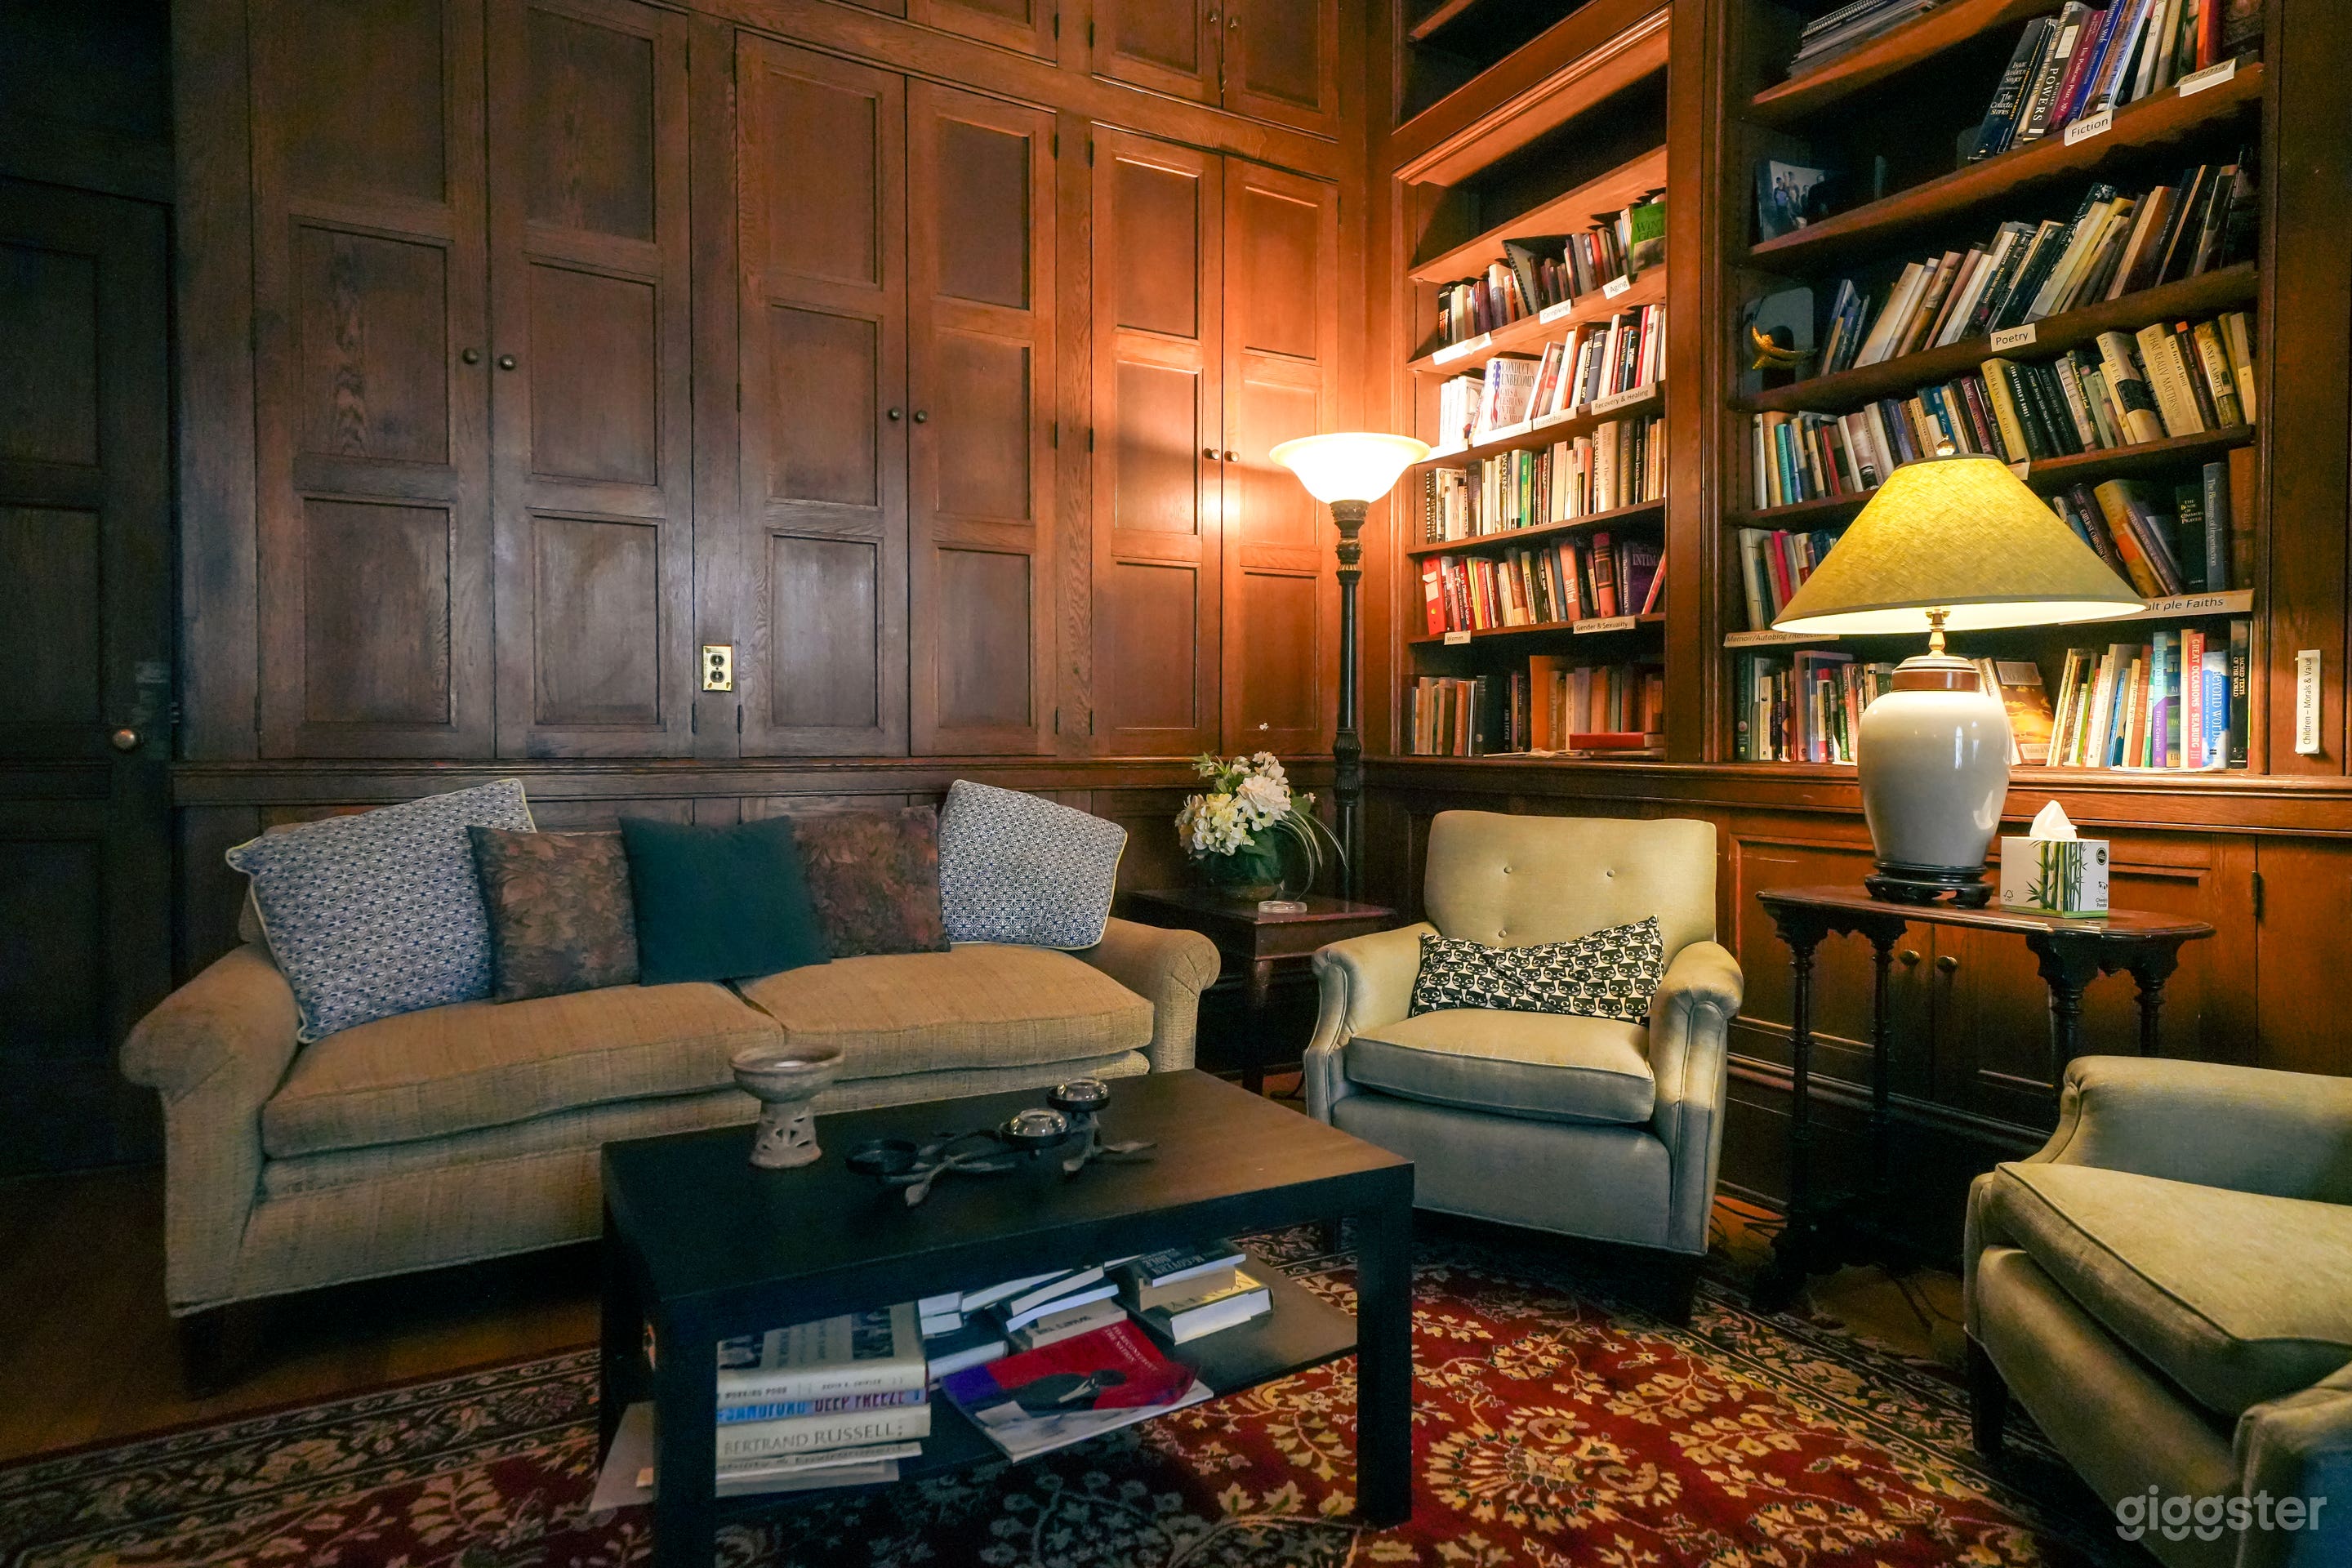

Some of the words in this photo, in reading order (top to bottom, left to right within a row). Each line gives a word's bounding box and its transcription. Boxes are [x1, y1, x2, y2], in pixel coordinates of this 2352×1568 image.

[2100, 27, 2111, 43] Web
[2004, 76, 2022, 84] Singer
[2183, 64, 2228, 82] Drama
[2001, 91, 2013, 100] The
[2032, 67, 2060, 122] POWERS
[2071, 118, 2109, 138] Fiction
[1610, 279, 1628, 293] Aging
[1542, 304, 1569, 319] Caregiving
[1995, 332, 2029, 345] Poetry
[2100, 337, 2121, 381] INSPIRED
[2148, 329, 2160, 350] WHAT
[2154, 351, 2168, 376] REALLY
[1502, 361, 1530, 375] CONDUCT
[2204, 341, 2212, 359] ANNE
[2210, 359, 2224, 393] LAMOTT
[1501, 373, 1535, 388] UNBECOMIN
[2179, 370, 2188, 386] Spirit
[1500, 395, 1523, 407] LESBIANS
[1594, 397, 1619, 409] Recovery
[1627, 389, 1649, 399] Healing
[1987, 364, 2000, 399] WORKING
[2002, 417, 2011, 434] GOD
[2013, 379, 2025, 402] LEOPOLD'S
[2021, 402, 2030, 417] GHOST
[1536, 416, 1561, 426] Friendship
[2207, 478, 2216, 490] The
[1430, 498, 1436, 511] ME
[2207, 491, 2216, 519] Blessings
[2208, 527, 2216, 566] Imperfection
[1565, 577, 1577, 604] Stiffed
[2145, 600, 2182, 612] ultple
[2186, 598, 2224, 608] Faiths
[1602, 621, 1628, 630] Sexuality
[2191, 638, 2199, 664] GREAT
[2191, 666, 2200, 707] OCCASIONS
[2303, 685, 2311, 709] Morals
[2191, 712, 2200, 748] SEABURG
[2303, 717, 2311, 745] Children
[1116, 1340, 1136, 1362] NATION
[725, 1388, 761, 1399] WORKING
[765, 1387, 787, 1396] POOR
[726, 1401, 806, 1421] SANDFORD
[814, 1396, 849, 1413] DEEP
[855, 1391, 904, 1408] FREEZE
[724, 1432, 808, 1456] BERTRAND
